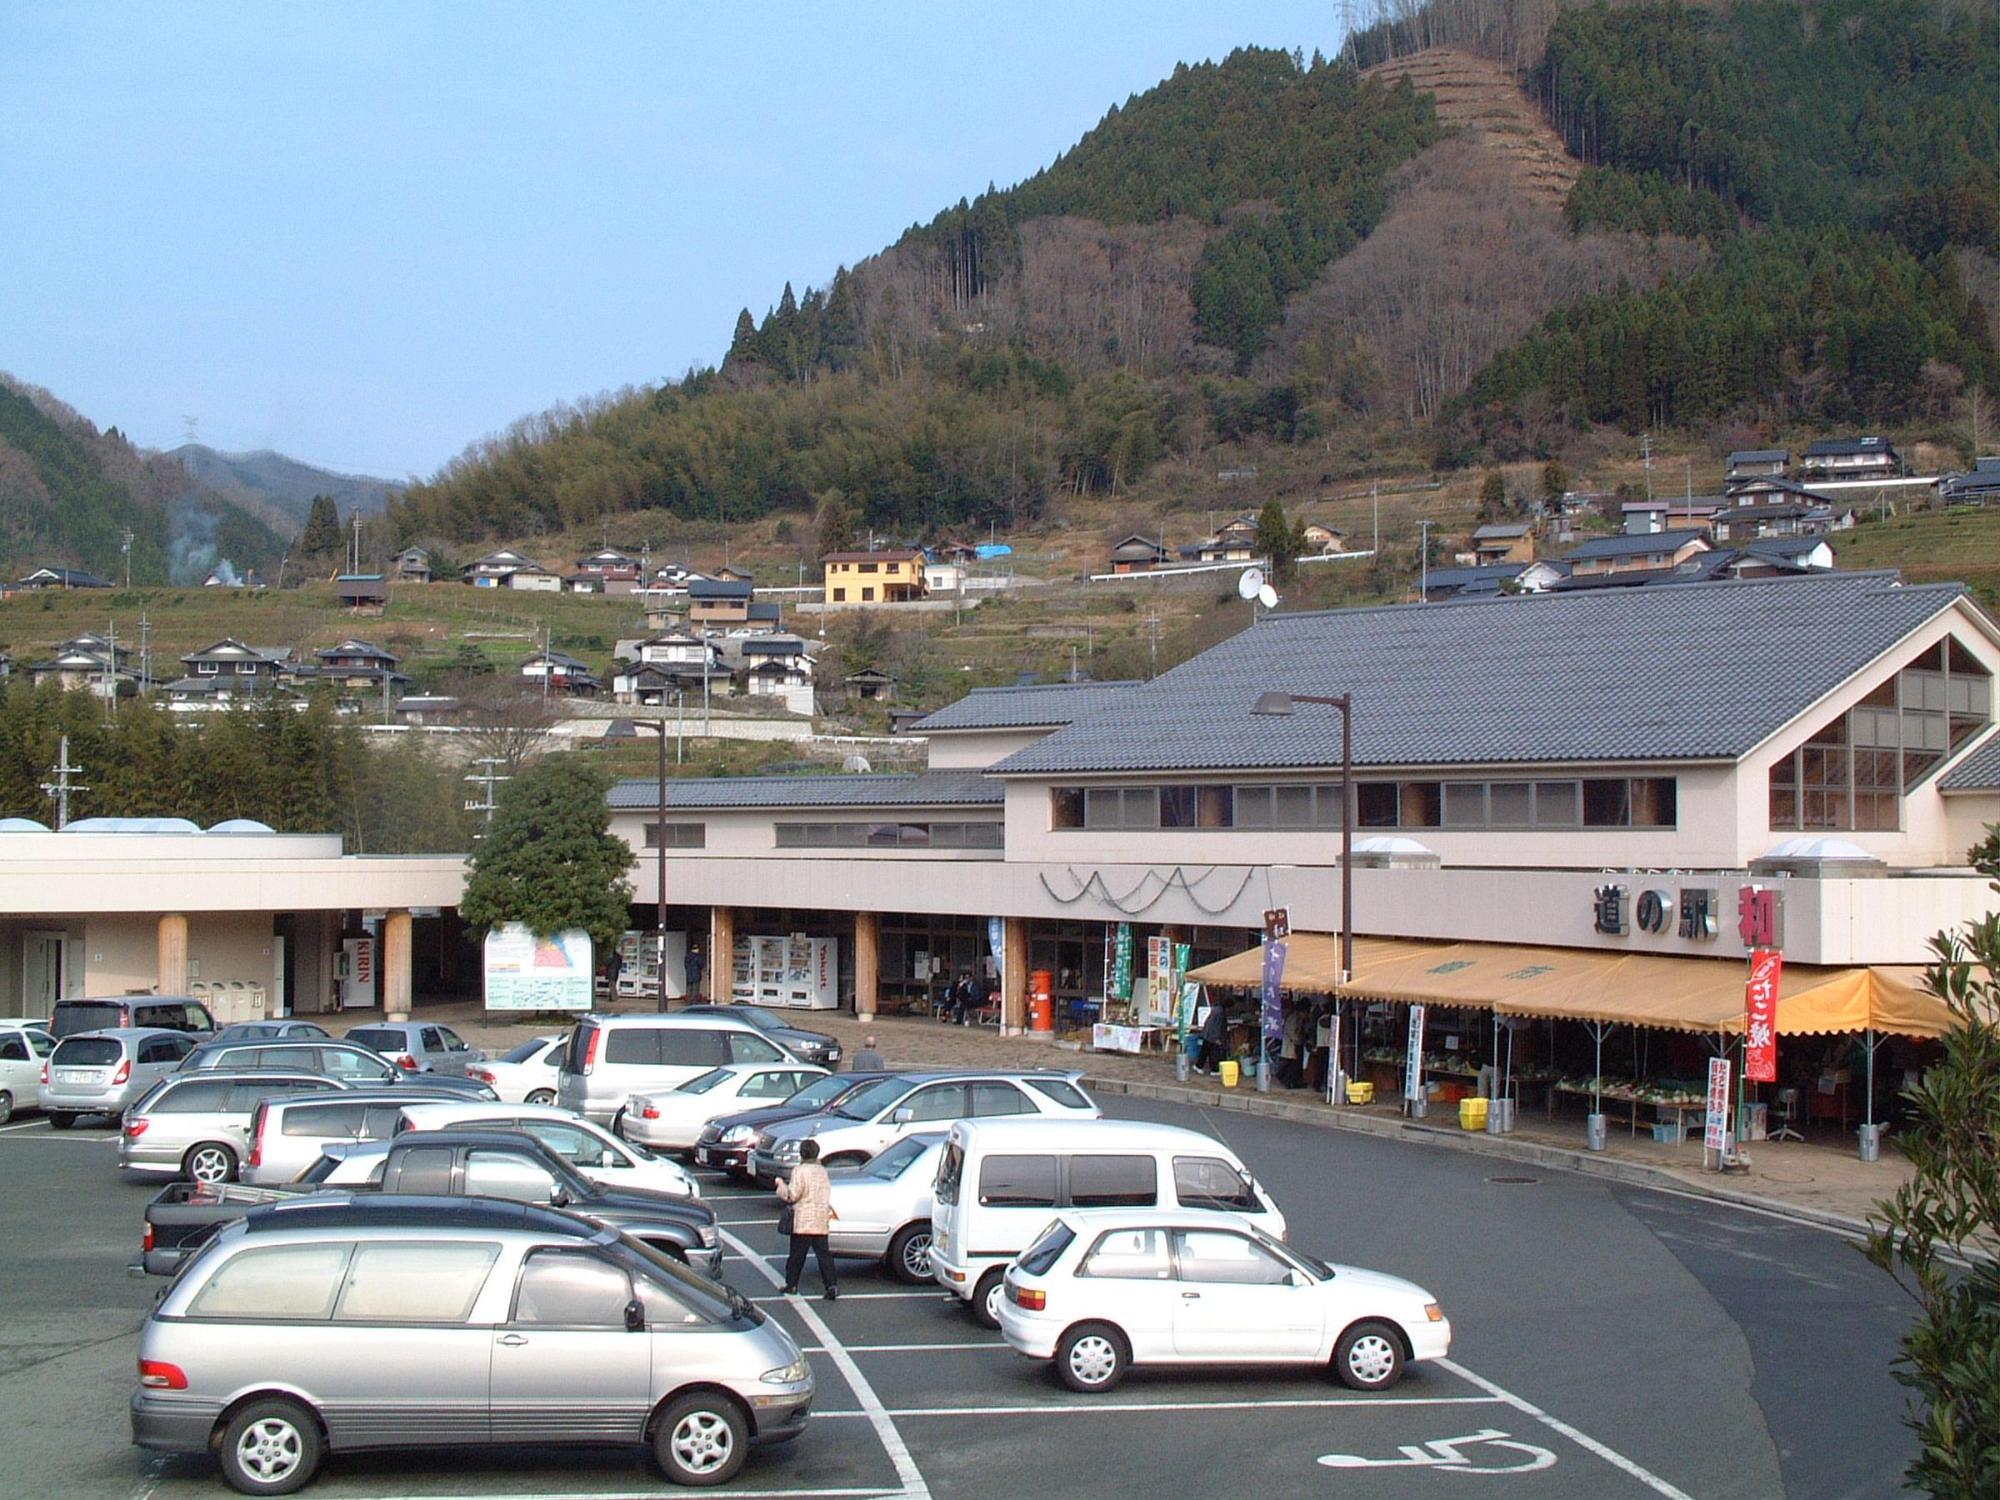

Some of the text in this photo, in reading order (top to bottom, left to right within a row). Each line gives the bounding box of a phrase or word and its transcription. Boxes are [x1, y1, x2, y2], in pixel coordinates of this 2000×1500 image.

[1594, 884, 1775, 947] 道の駅 和
[357, 940, 370, 984] KIRIN
[819, 943, 830, 991] Yakult
